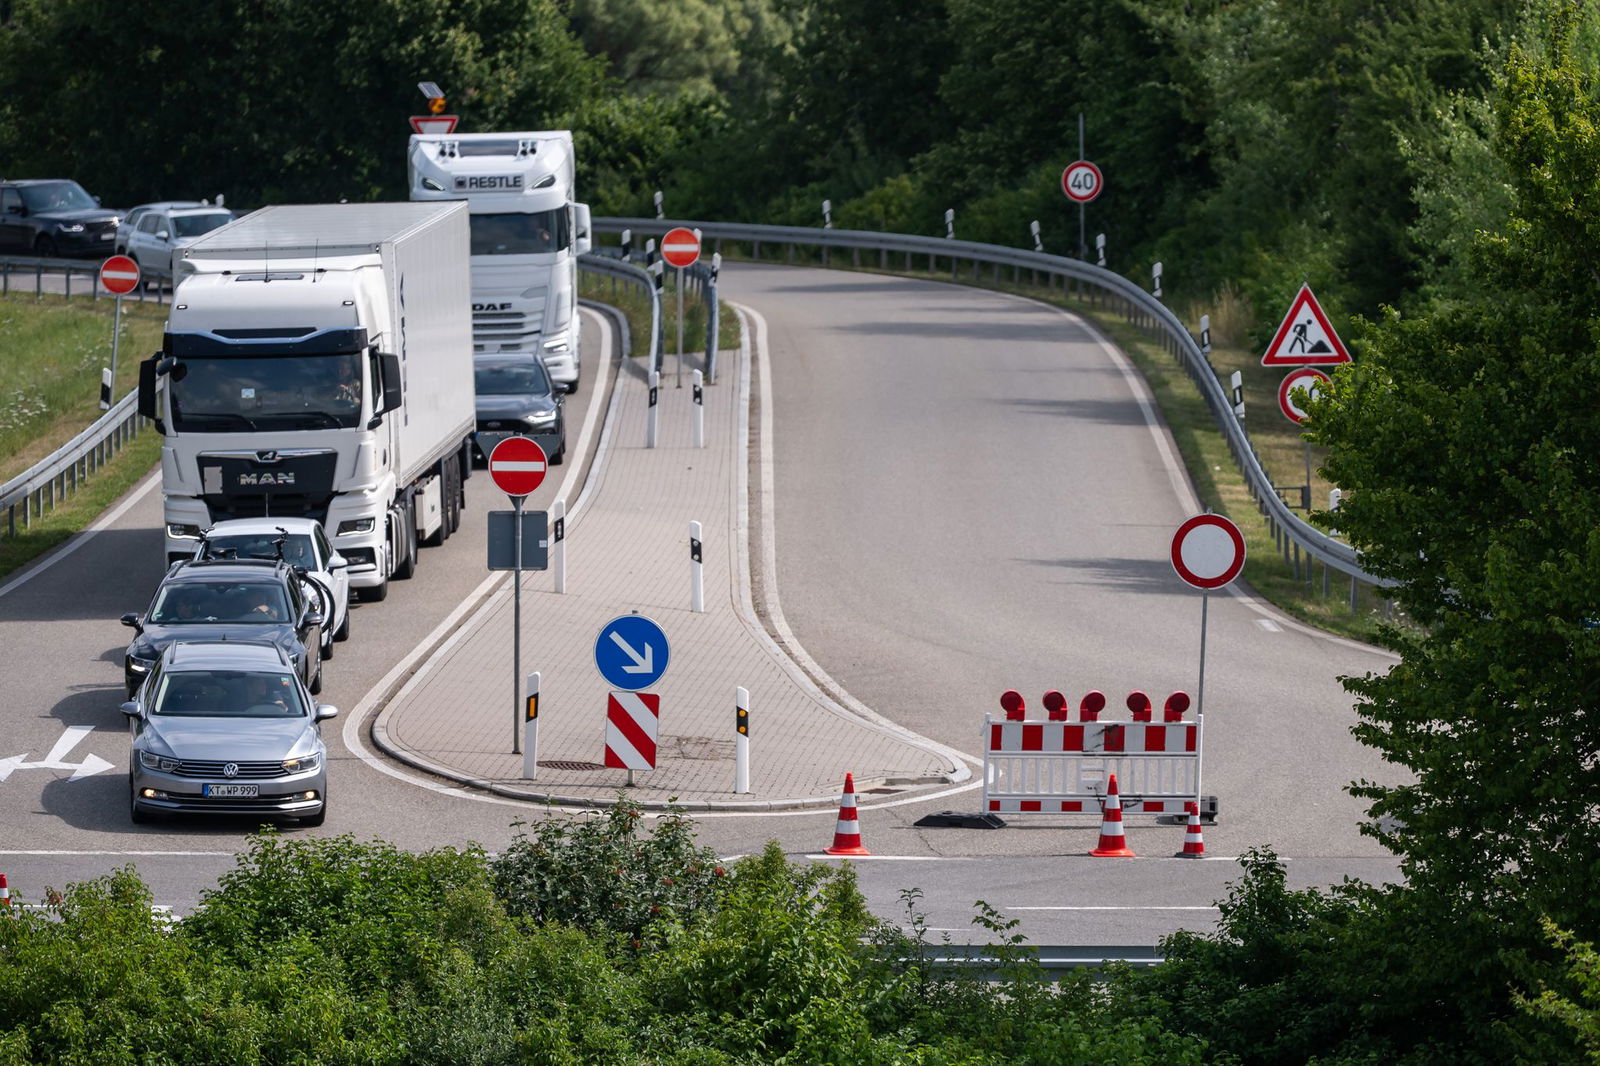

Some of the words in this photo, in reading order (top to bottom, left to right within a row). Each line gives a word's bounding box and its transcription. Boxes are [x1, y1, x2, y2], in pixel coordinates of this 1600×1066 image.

[469, 175, 522, 189] RESTLE
[1071, 172, 1094, 190] 40
[472, 302, 512, 311] DAF
[240, 472, 295, 485] MAN
[240, 786, 257, 796] 999
